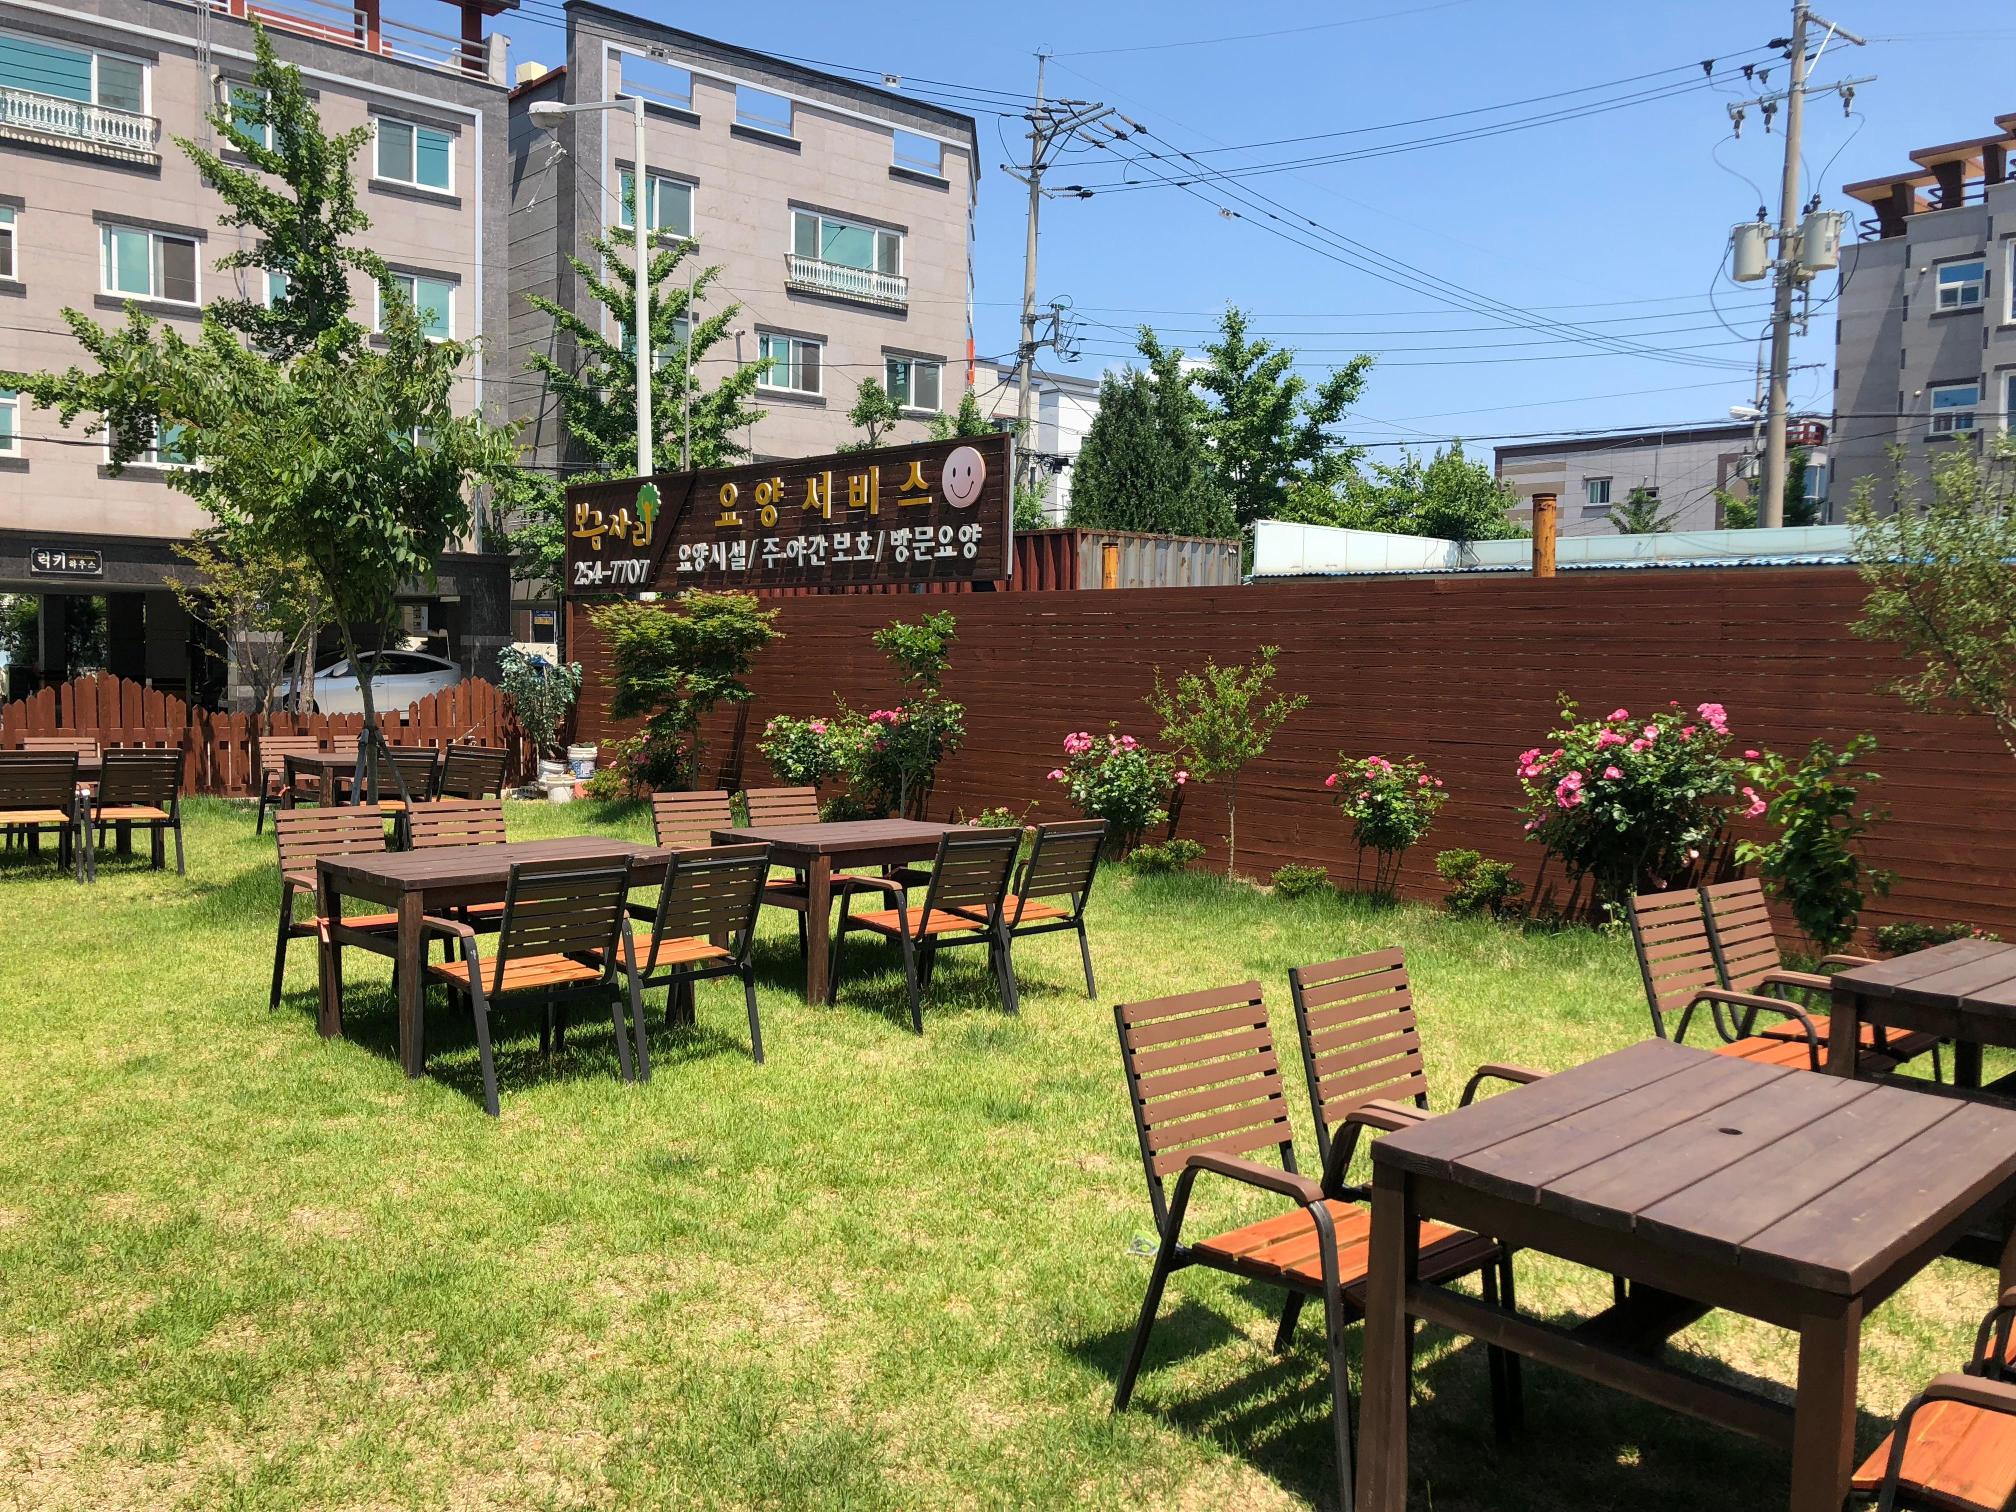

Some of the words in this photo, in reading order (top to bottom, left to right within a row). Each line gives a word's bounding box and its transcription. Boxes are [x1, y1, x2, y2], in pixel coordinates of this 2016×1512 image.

[714, 461, 933, 528] 요양서비스
[572, 502, 653, 551] 보금자리
[37, 551, 66, 570] 럭키
[68, 559, 97, 570] 하우스
[573, 558, 651, 585] 254-7707
